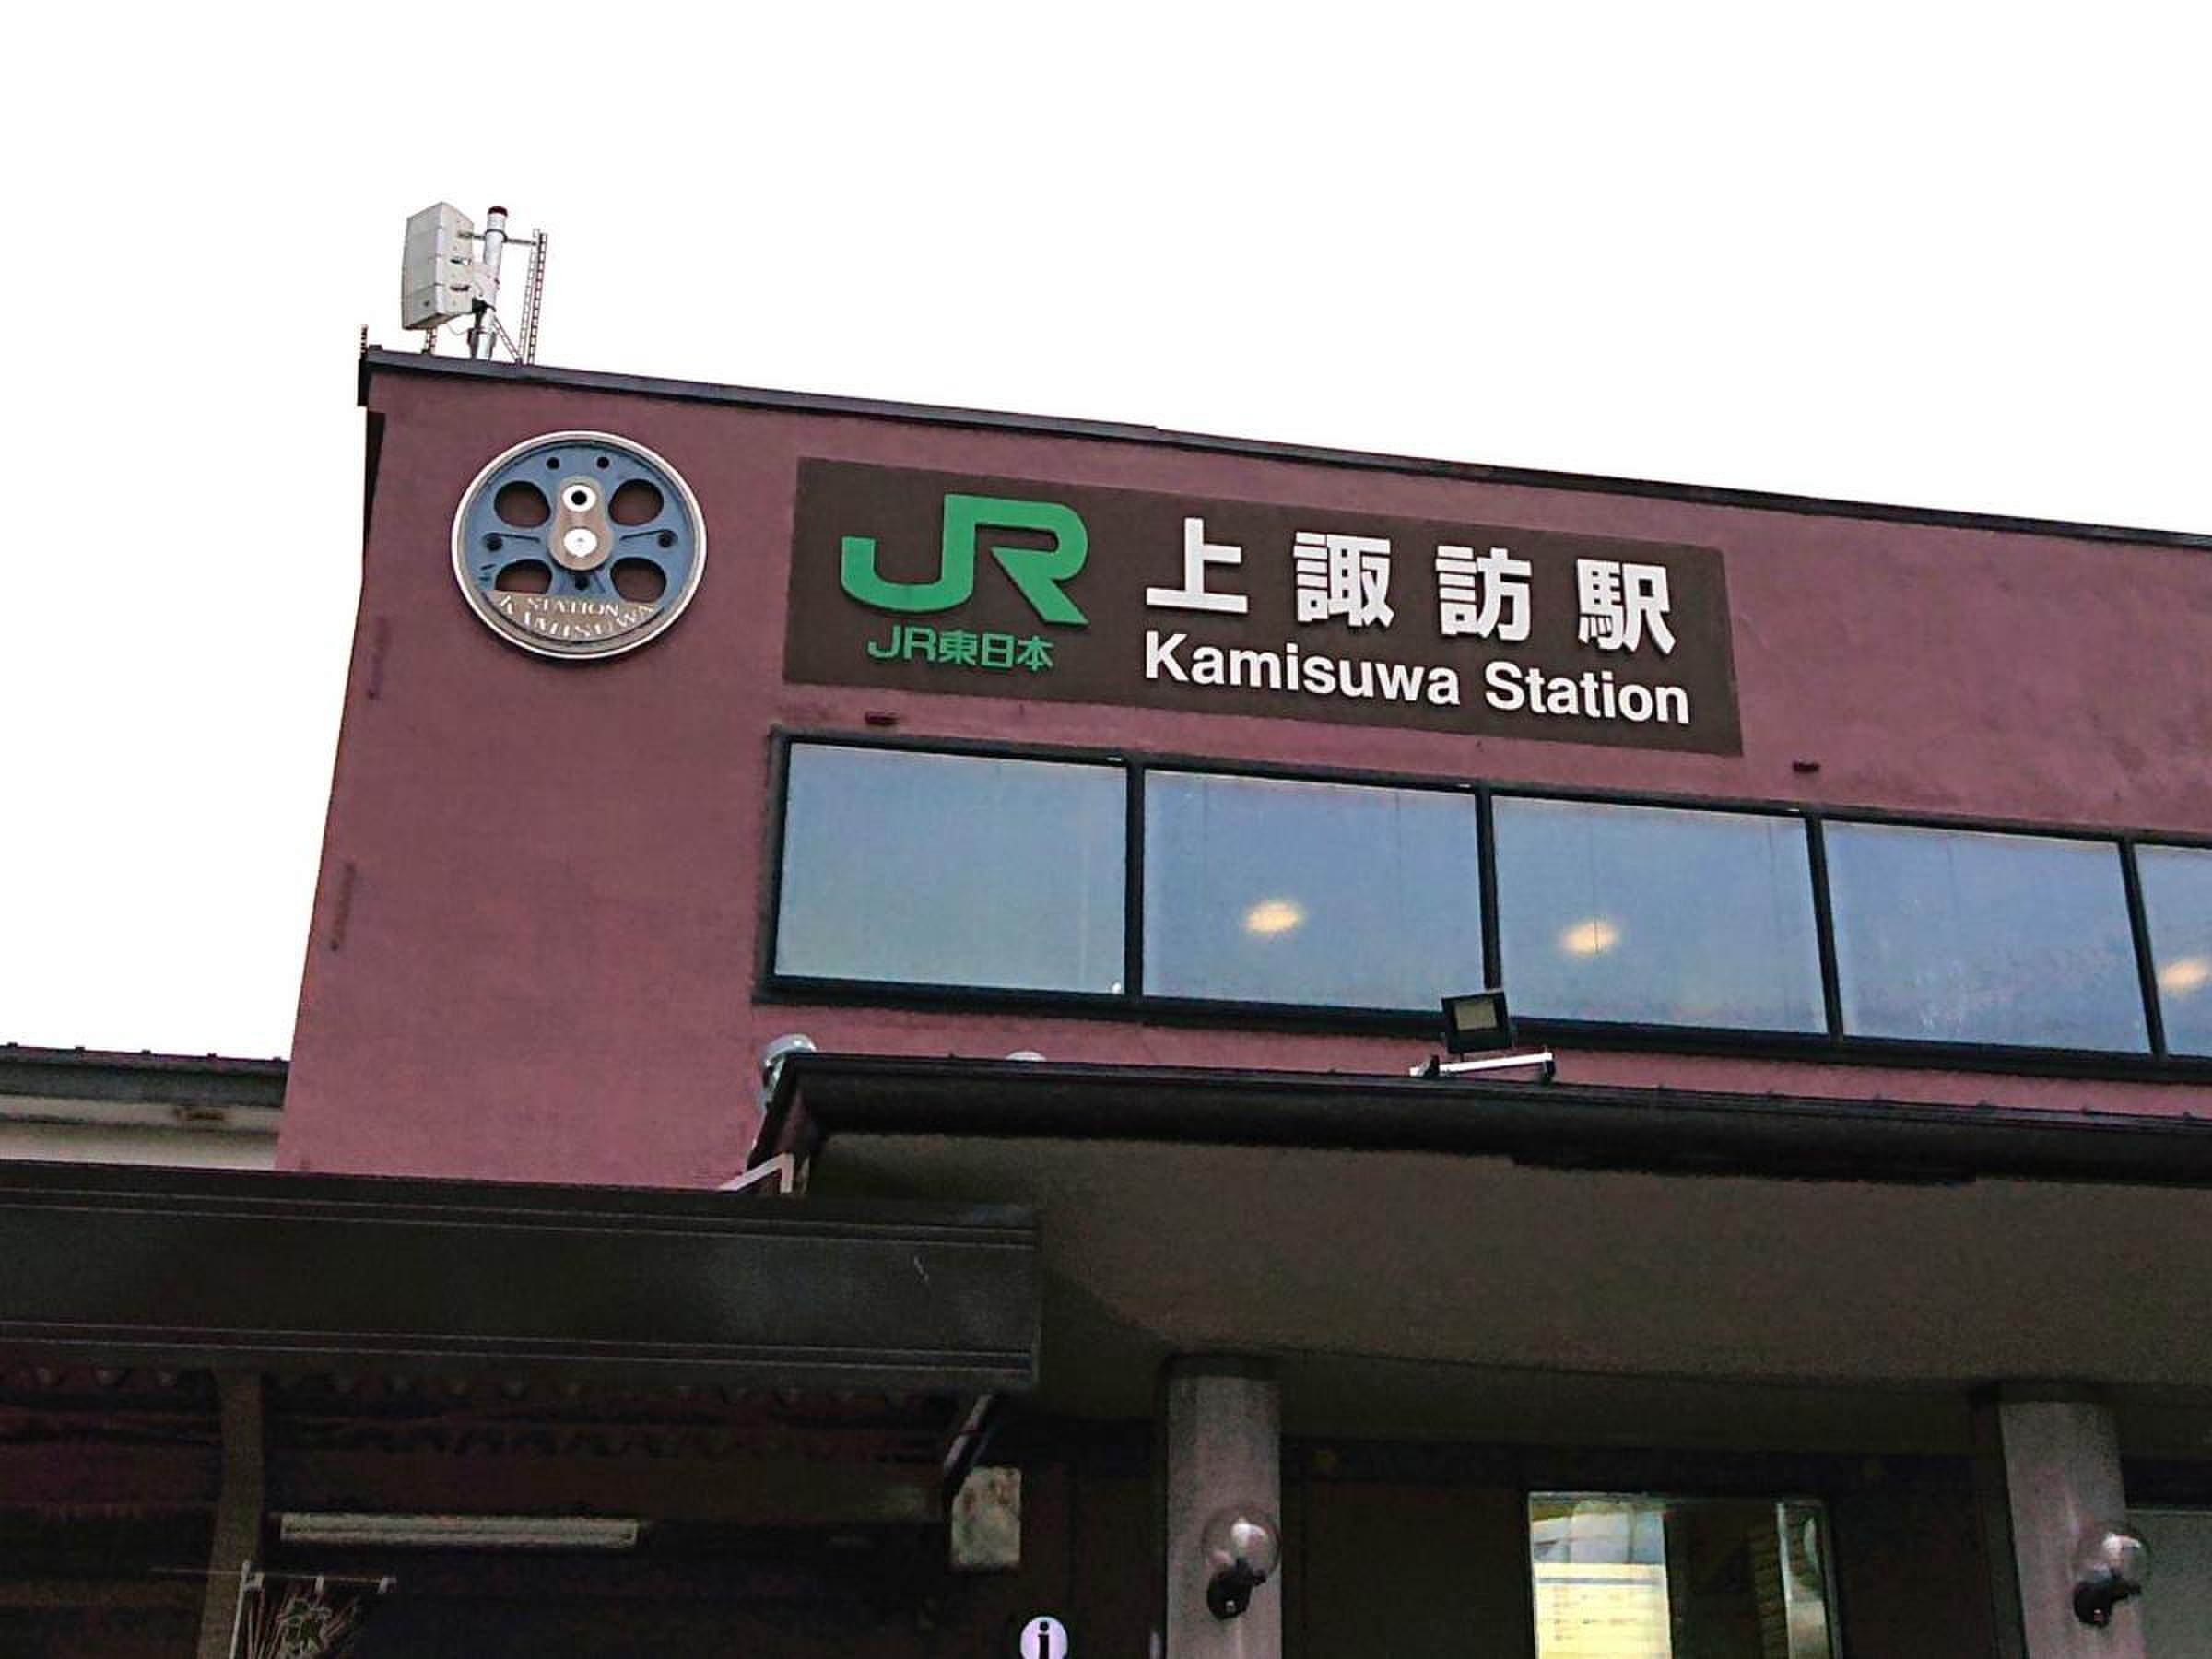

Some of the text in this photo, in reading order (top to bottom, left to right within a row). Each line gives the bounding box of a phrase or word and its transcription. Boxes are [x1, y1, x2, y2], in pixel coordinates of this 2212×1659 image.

[527, 597, 618, 616] STATION
[841, 494, 1088, 625] JR
[1146, 517, 1676, 654] 上諏訪駅
[867, 624, 1054, 671] JR東日本
[1145, 630, 1690, 724] Kamisuwa Station
